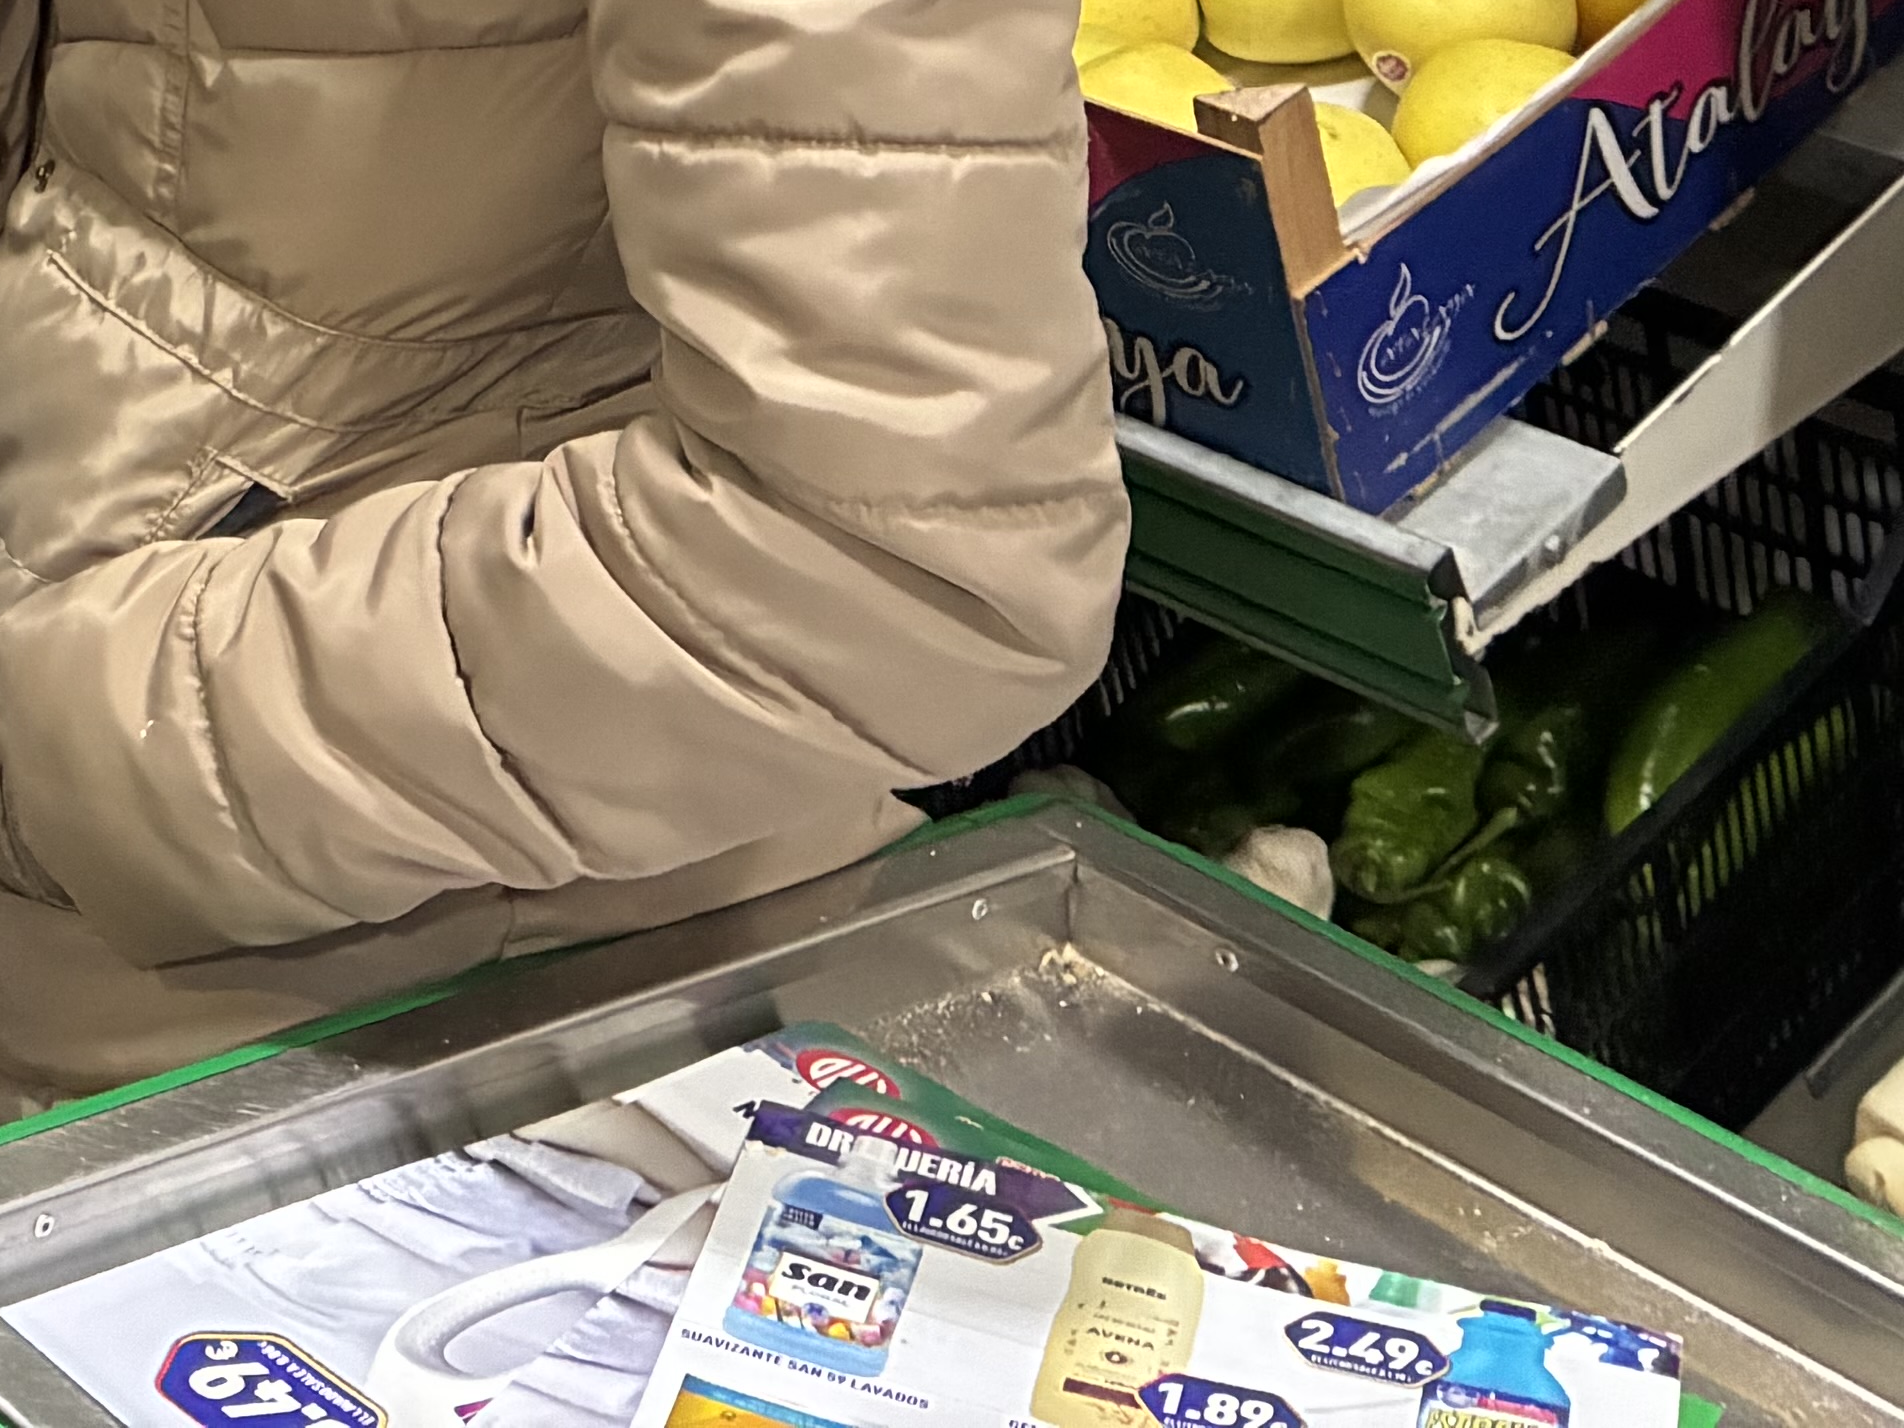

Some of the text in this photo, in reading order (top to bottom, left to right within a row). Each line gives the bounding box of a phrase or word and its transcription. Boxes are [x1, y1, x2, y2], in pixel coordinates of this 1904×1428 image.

[805, 1121, 996, 1196] DRUERÍA
[782, 1262, 872, 1302] san
[680, 1328, 781, 1366] SUAVIZANTE
[787, 1359, 823, 1379] SAN
[850, 1379, 930, 1410] LAVADOS
[1086, 1326, 1155, 1351] AVENA
[188, 1340, 349, 1428] .49€
